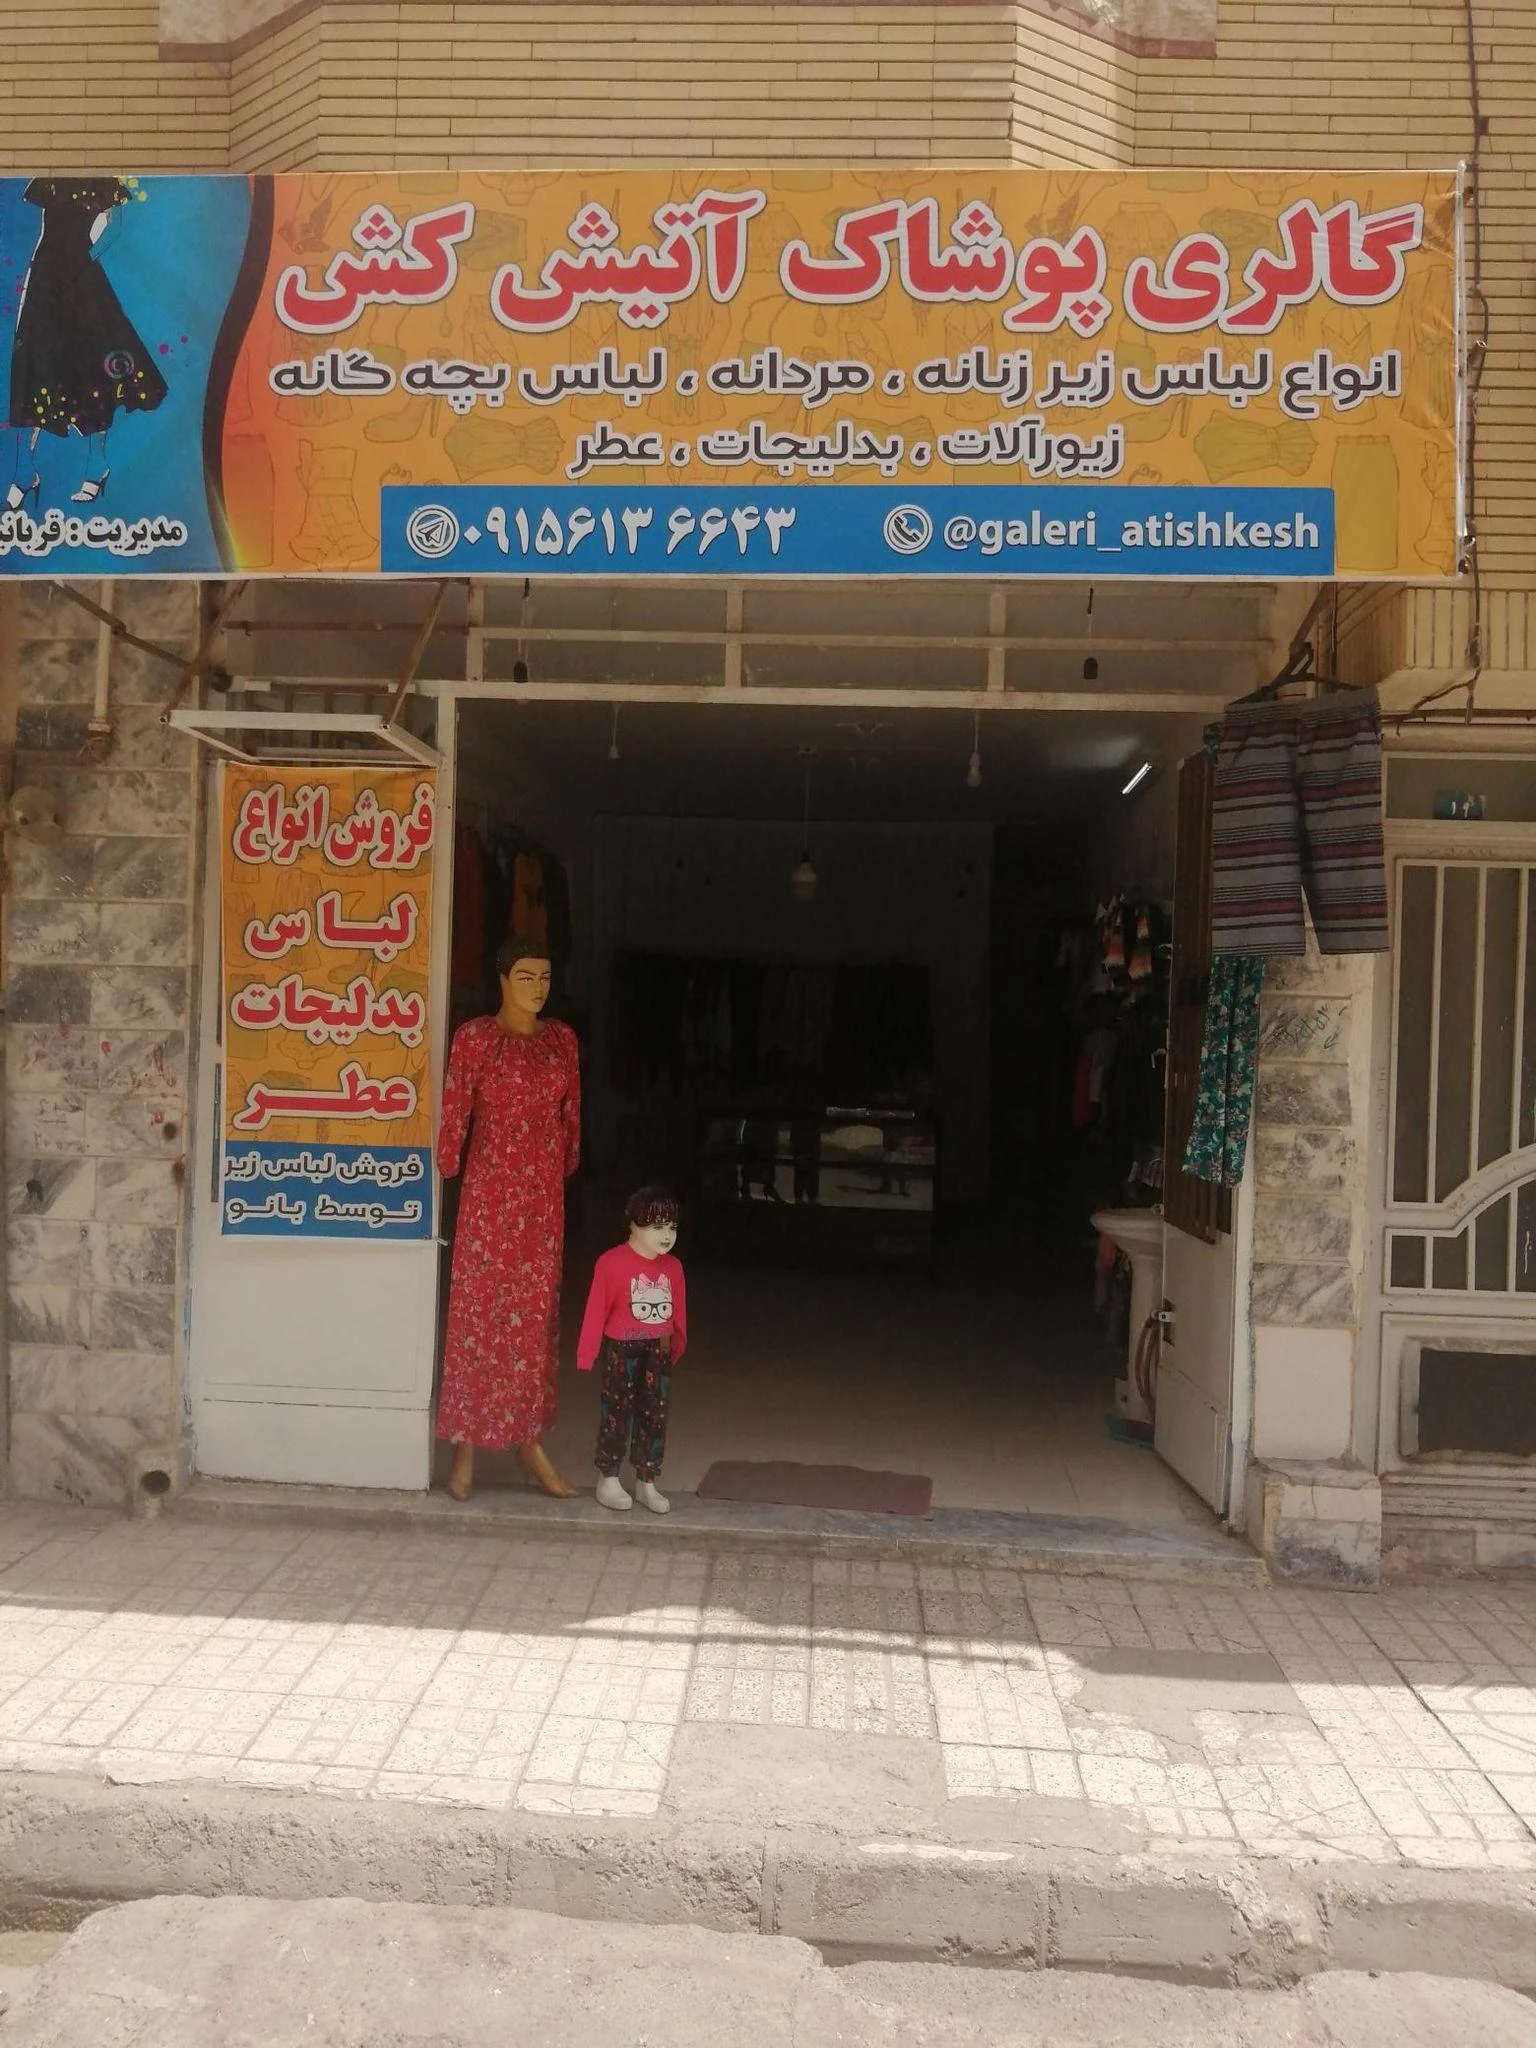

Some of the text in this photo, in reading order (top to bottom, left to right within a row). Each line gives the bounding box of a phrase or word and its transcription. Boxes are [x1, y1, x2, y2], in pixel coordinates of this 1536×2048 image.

[282, 195, 1418, 331] گالری پوشاک آتیش کش
[273, 351, 393, 392] گانه
[404, 361, 507, 411] بچه
[521, 351, 663, 403] لباس
[710, 350, 871, 404] مردانه
[916, 350, 1029, 404] زنانه
[1039, 352, 1112, 404] زیر
[1124, 351, 1270, 404] لباس
[1283, 352, 1398, 415] انواع
[569, 425, 662, 474] عطر
[700, 424, 900, 473] بدلیجات
[940, 418, 1125, 474] زیورآلات
[86, 515, 184, 552] مدیریت
[942, 509, 1319, 555] @galeri_atishkesh
[237, 787, 434, 865] فروش انواع
[235, 979, 421, 1043] بدلیجات
[238, 1066, 412, 1125] عطر
[224, 1153, 422, 1185] فروش لباس زیر
[228, 1194, 420, 1226] توسط بانو
